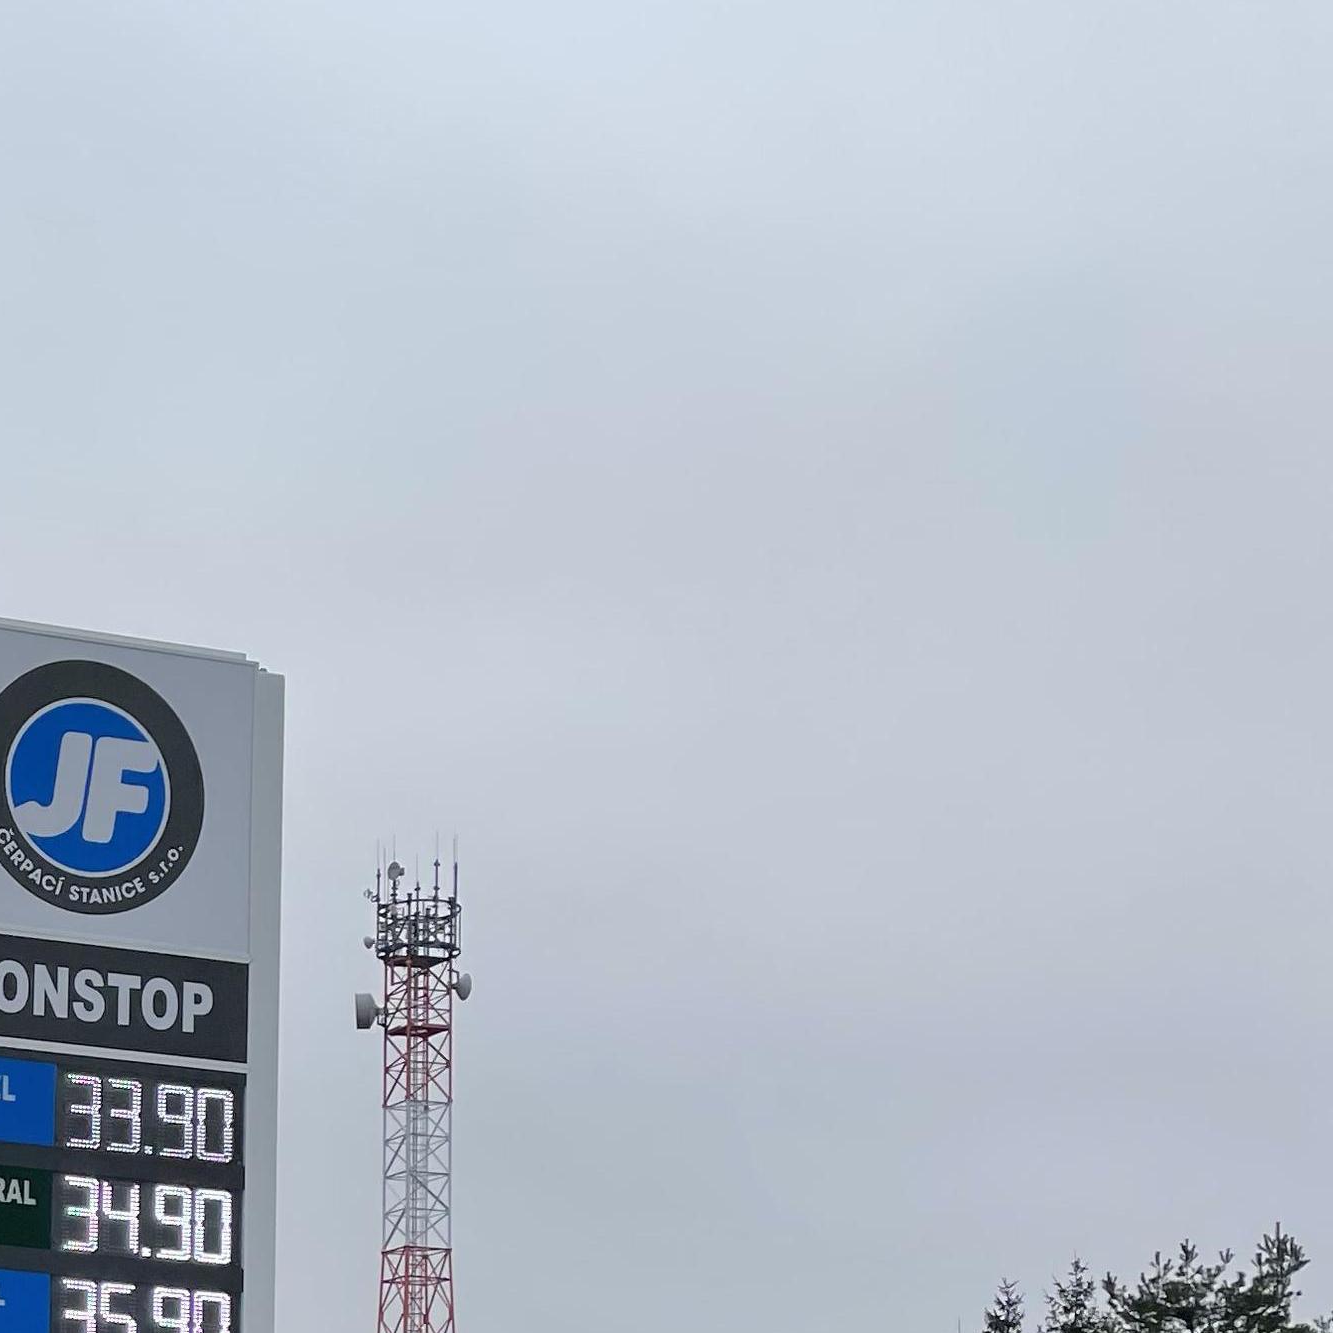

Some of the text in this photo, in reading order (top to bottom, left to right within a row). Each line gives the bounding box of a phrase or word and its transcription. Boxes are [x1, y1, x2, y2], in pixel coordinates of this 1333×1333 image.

[14, 731, 159, 843] JF
[68, 877, 146, 904] STANICE
[148, 846, 183, 884] s.r.o.
[64, 1073, 233, 1163] 33.90
[62, 1175, 232, 1266] 34.90
